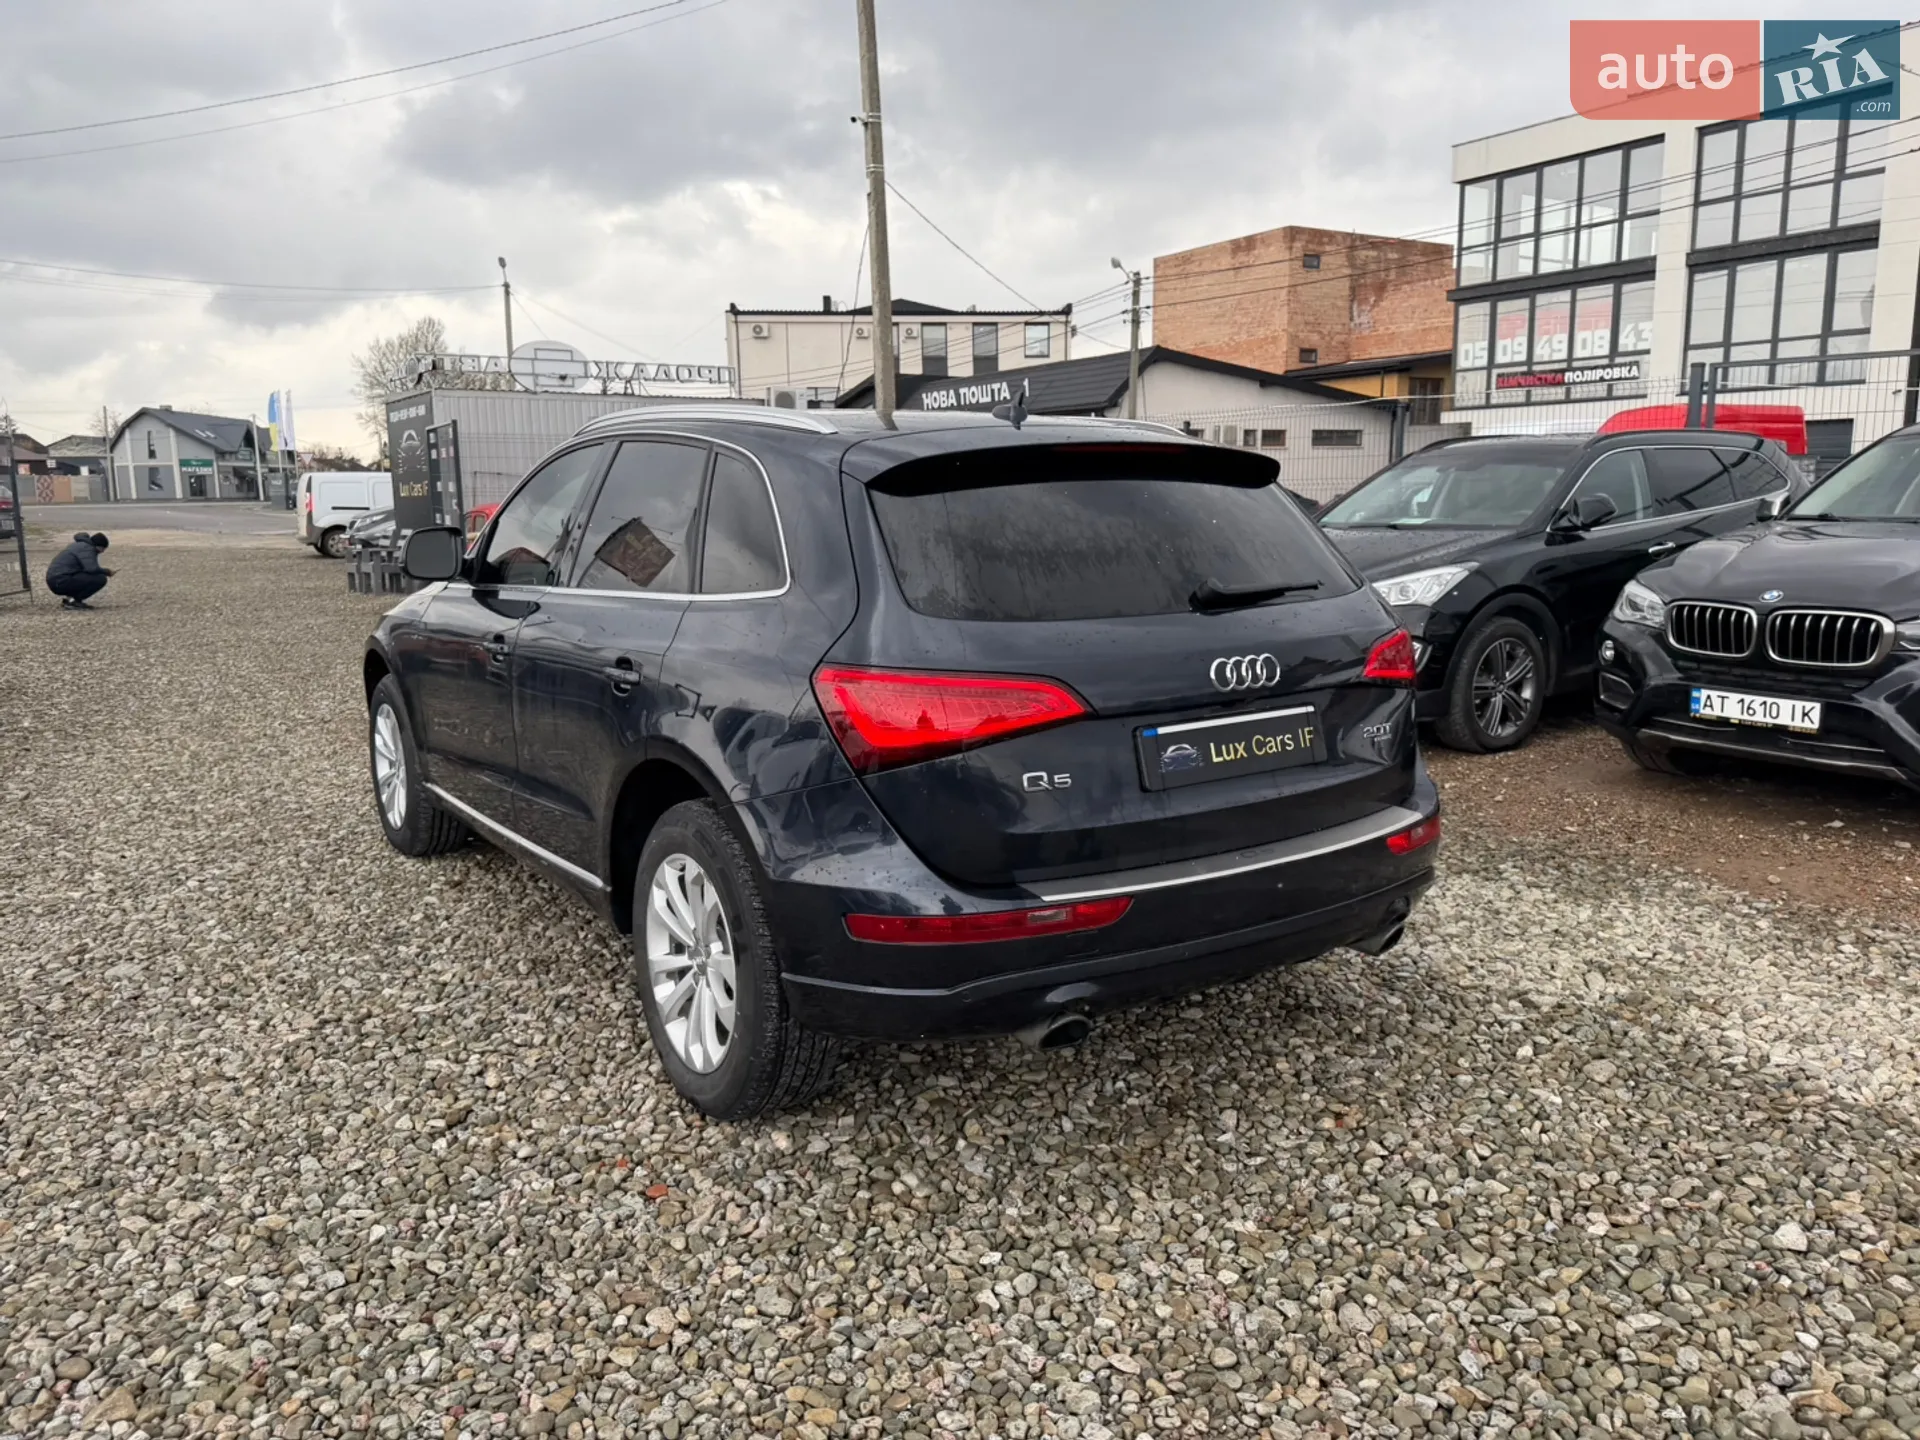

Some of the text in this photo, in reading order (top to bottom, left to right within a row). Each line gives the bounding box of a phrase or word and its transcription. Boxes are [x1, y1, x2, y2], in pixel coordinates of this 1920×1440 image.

[1496, 337, 1528, 364] 09
[1535, 333, 1568, 361] 49
[1575, 329, 1611, 358] 08
[1564, 365, 1640, 384] ПОЛІРОВКА
[921, 389, 958, 411] НОВА
[958, 381, 1011, 406] ПОШТА
[1702, 693, 1817, 725] AT 1610 IK
[1208, 726, 1316, 763] Lux Cars IF
[1021, 771, 1072, 793] Q5
